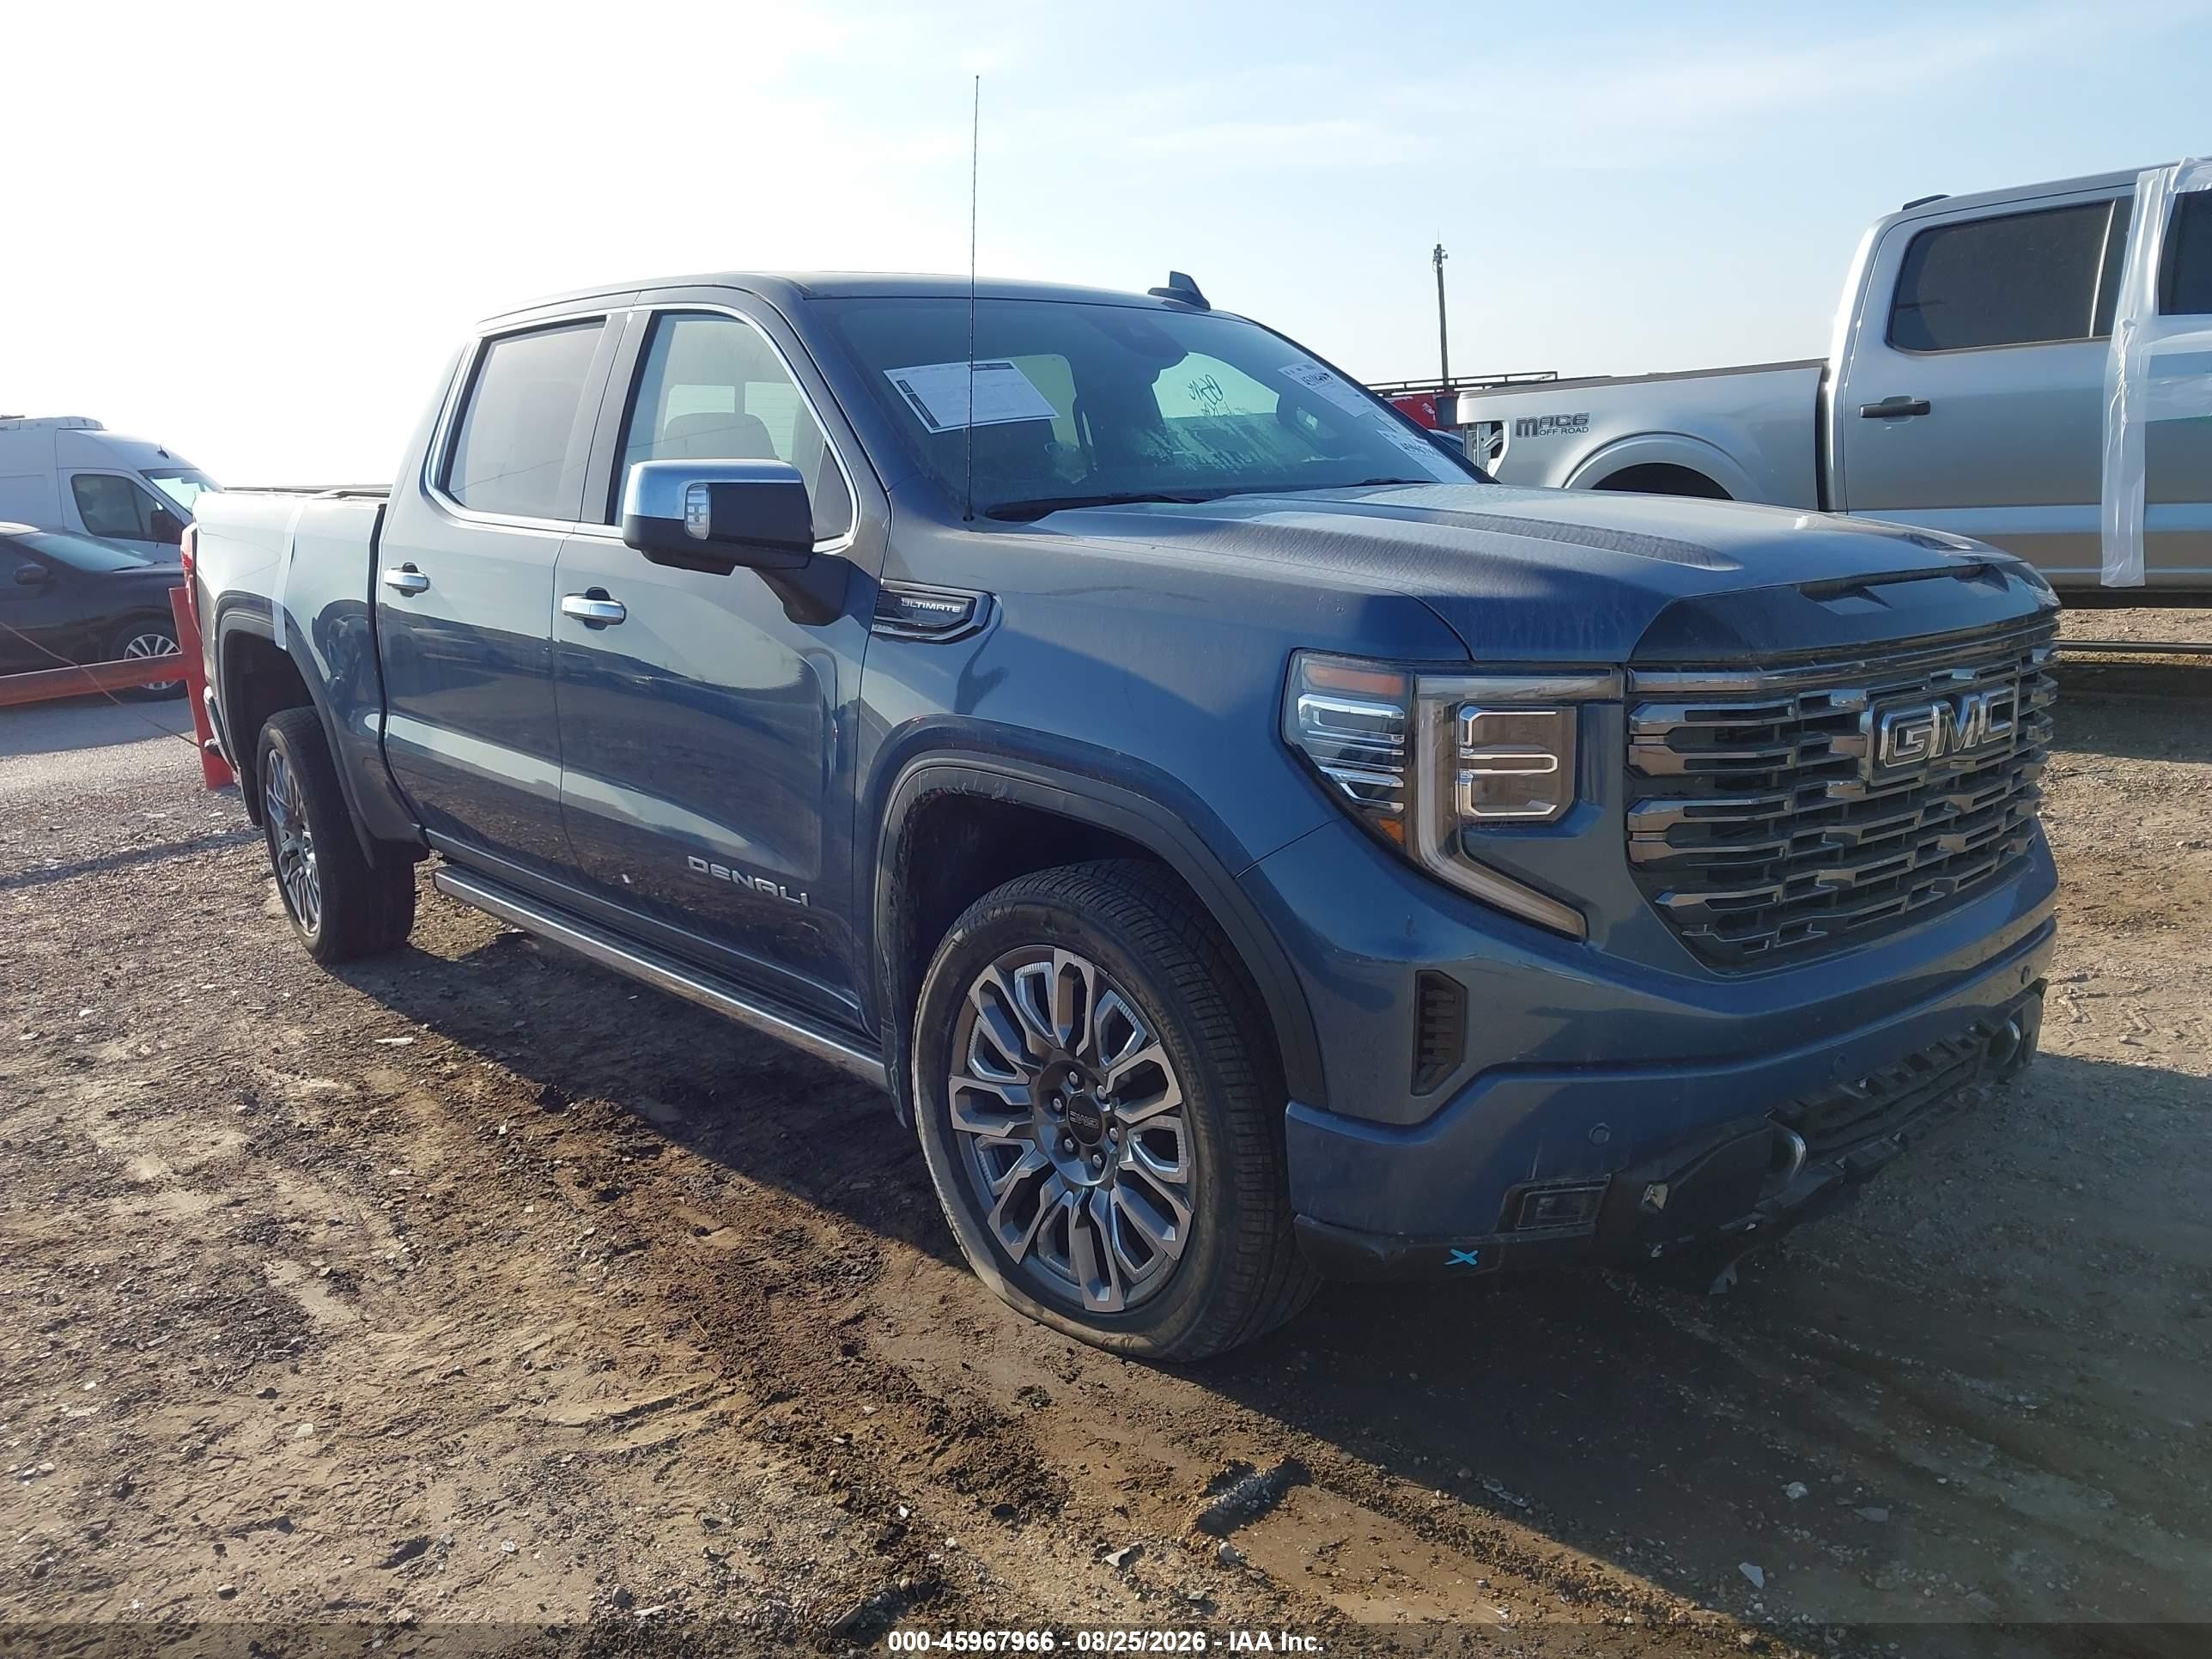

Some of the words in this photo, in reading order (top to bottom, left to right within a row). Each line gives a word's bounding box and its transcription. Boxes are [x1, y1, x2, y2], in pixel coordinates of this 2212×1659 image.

[1560, 426, 1589, 434] ROAD
[901, 598, 962, 613] ULTIMATE
[1879, 687, 2014, 768] GMC
[687, 855, 809, 908] DENALI
[1069, 1110, 1099, 1129] GMC
